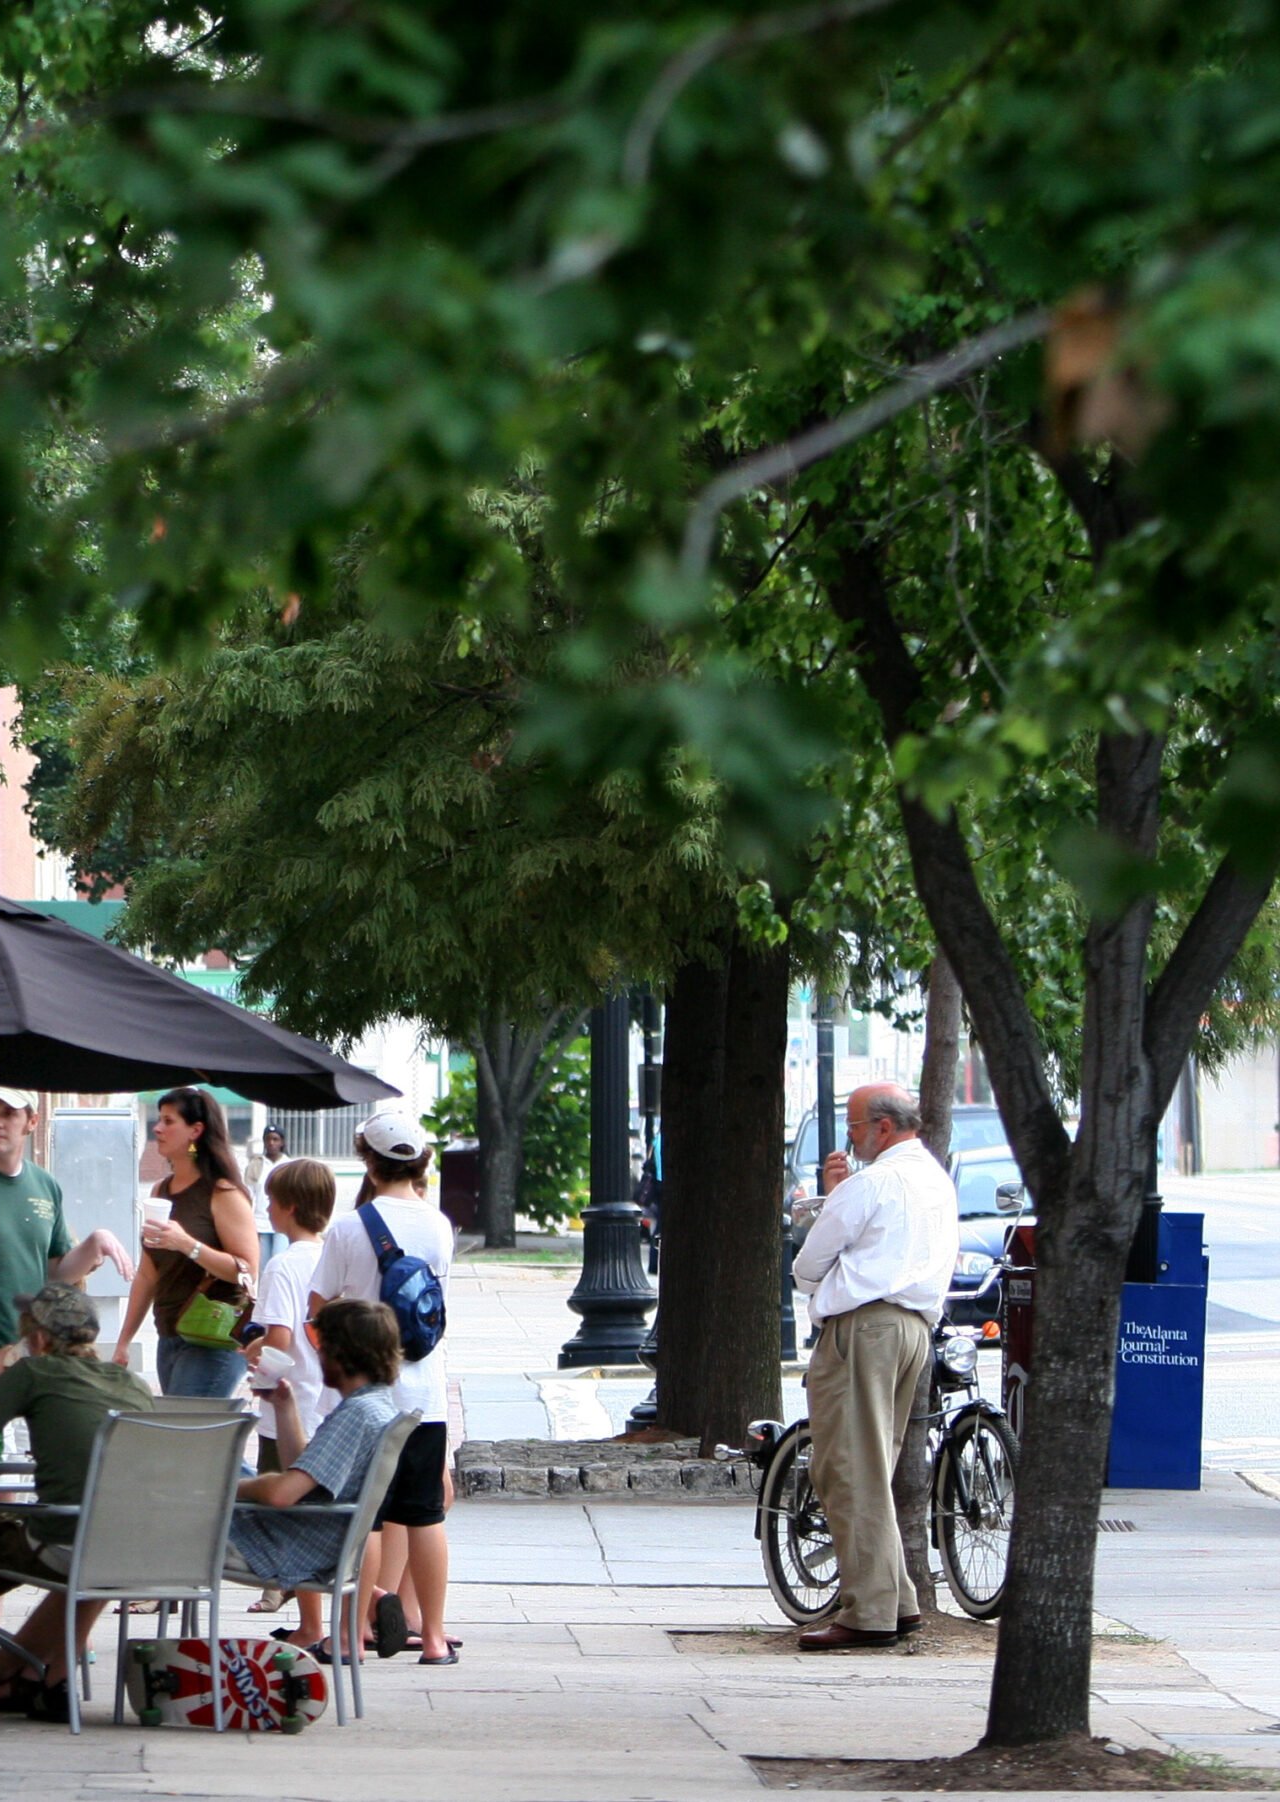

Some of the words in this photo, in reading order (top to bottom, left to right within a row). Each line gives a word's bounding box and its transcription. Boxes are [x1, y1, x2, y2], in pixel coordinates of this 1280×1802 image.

[1124, 1321, 1145, 1334] The
[1142, 1325, 1188, 1341] Atlanta
[1117, 1338, 1171, 1353] Journal-
[1121, 1351, 1199, 1367] Constitution
